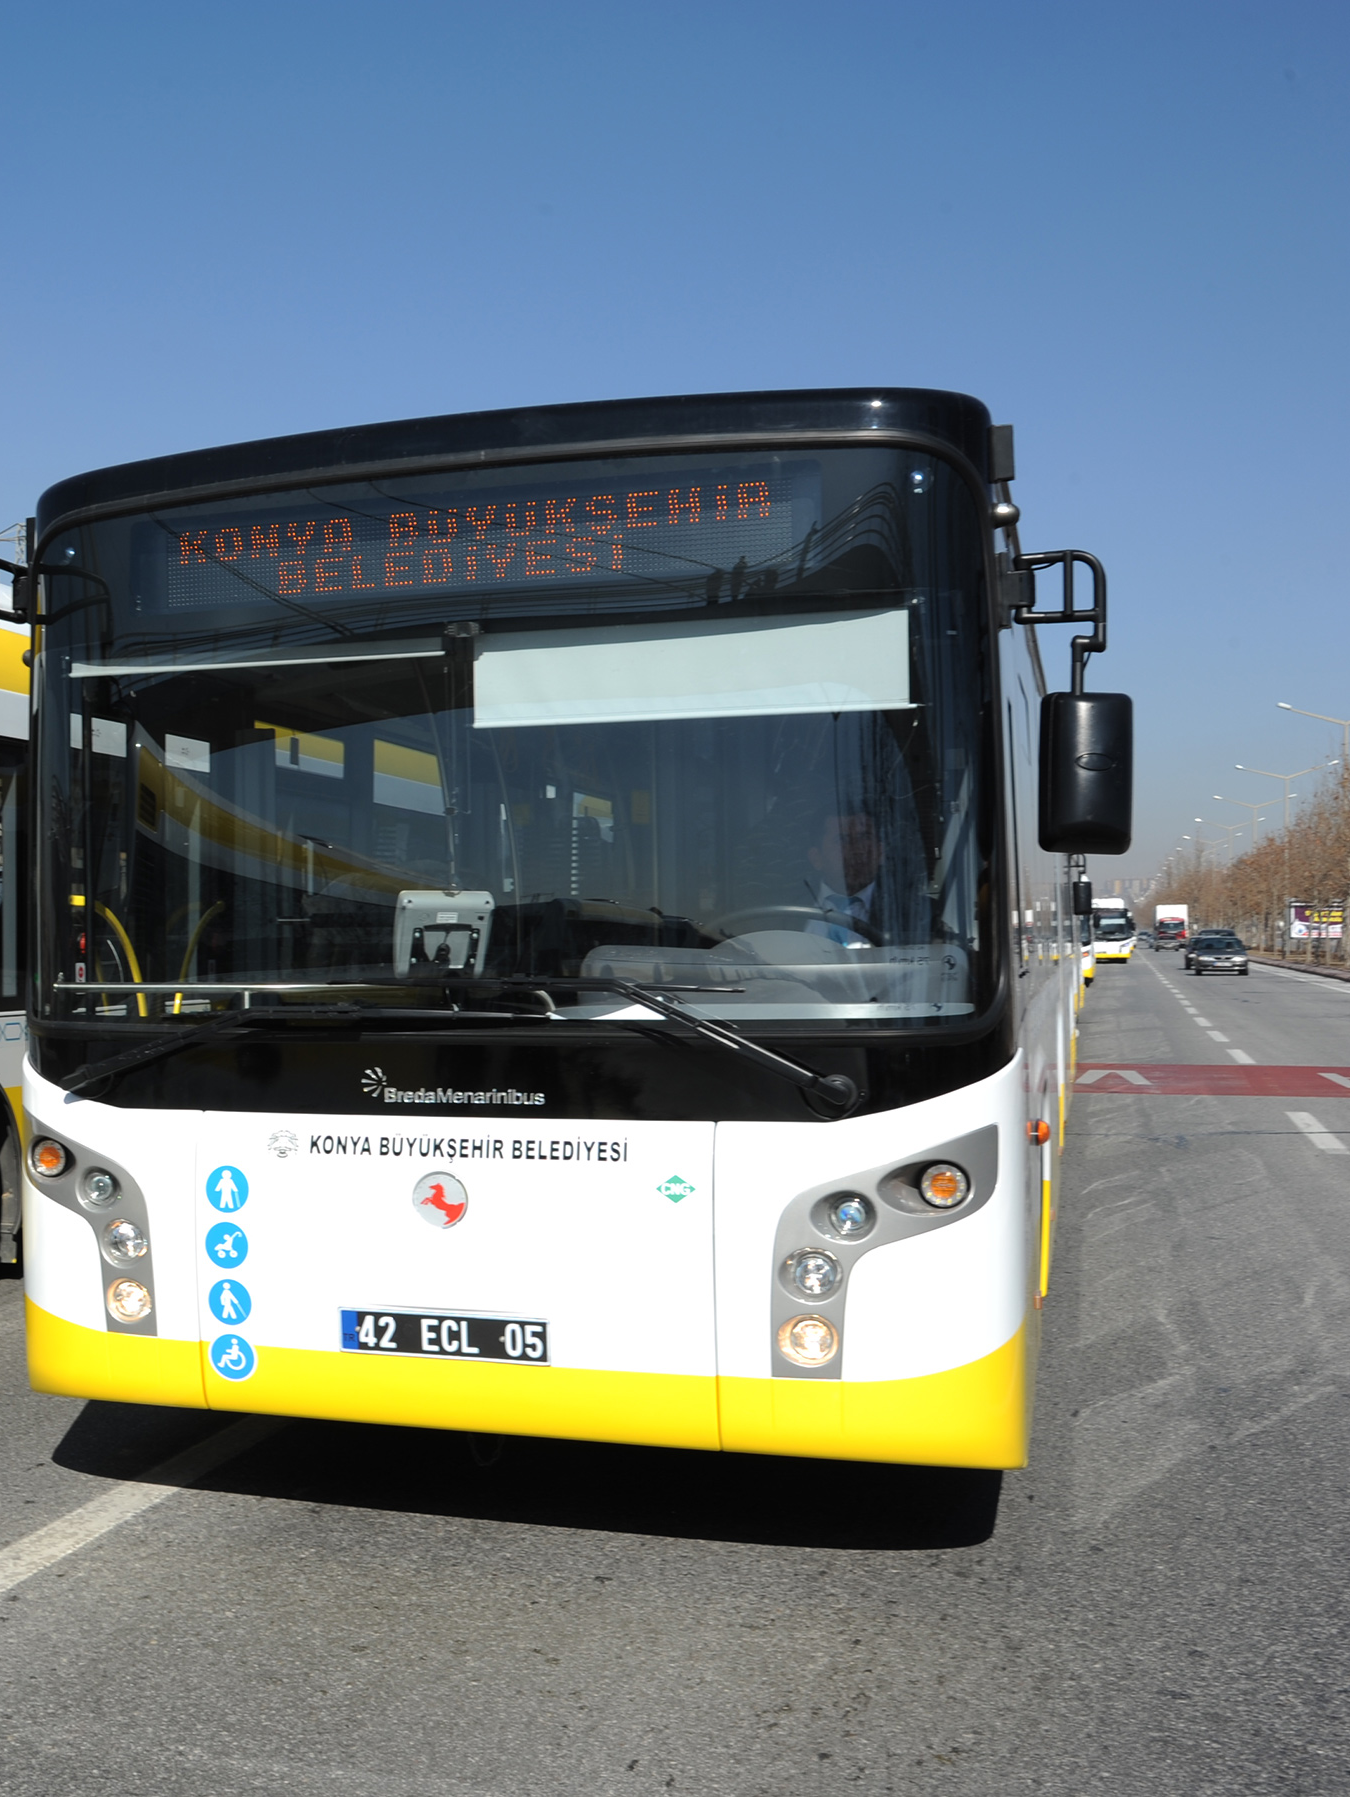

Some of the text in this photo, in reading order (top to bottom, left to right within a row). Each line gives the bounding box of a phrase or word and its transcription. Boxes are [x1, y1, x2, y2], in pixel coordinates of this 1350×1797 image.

[180, 518, 353, 564] KONYA
[383, 1087, 546, 1105] BredaMenarinibus
[310, 1133, 628, 1163] KONYA BÜYÜKŞEHİR BELEDİYESİ
[661, 1182, 691, 1196] CNG
[358, 1315, 398, 1349] 42
[420, 1318, 480, 1354] ECL
[504, 1322, 544, 1359] 05
